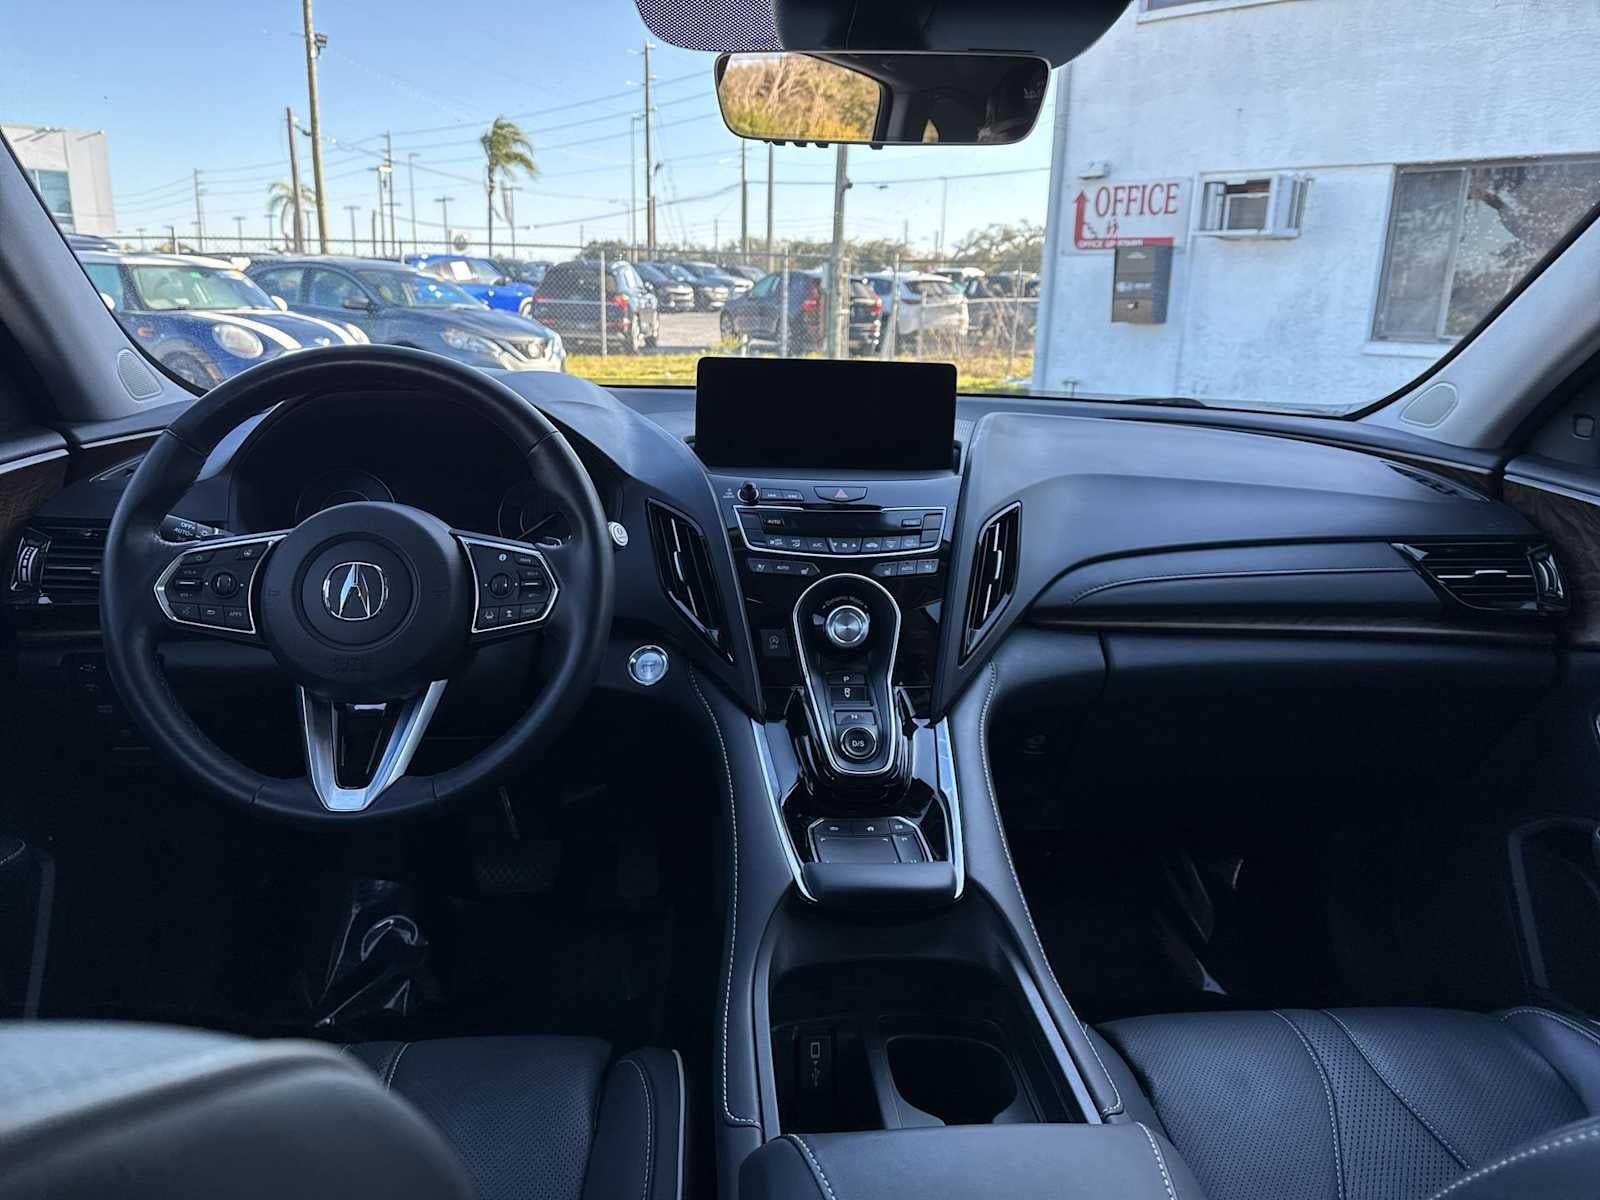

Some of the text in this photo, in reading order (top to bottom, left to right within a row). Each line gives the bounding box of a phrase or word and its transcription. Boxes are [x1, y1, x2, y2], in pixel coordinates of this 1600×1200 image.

[1095, 183, 1180, 217] OFFICE
[174, 527, 190, 536] AUTO
[852, 740, 865, 748] D/S
